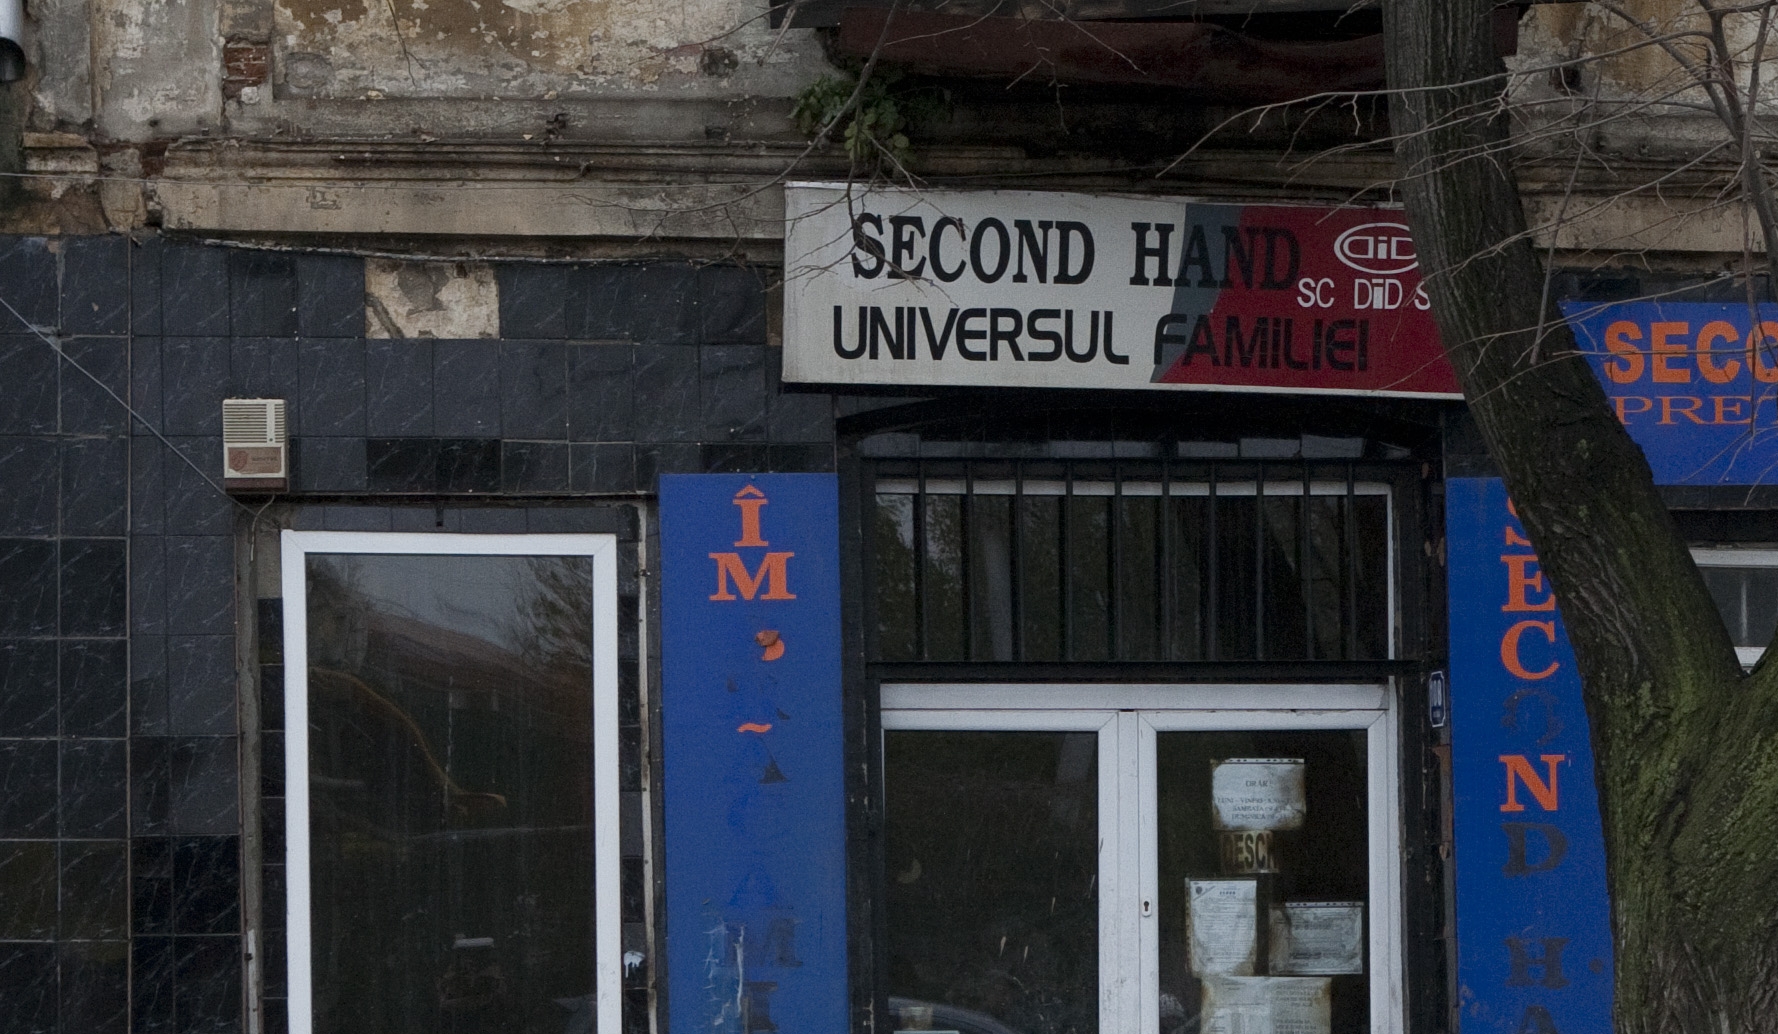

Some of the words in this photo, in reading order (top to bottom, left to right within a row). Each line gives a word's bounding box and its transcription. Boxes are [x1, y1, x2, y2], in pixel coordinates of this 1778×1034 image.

[851, 212, 1095, 286] SECOND
[1129, 223, 1300, 291] HAND
[1297, 277, 1335, 308] SC
[832, 305, 1130, 365] UNIVERSUL
[1152, 314, 1370, 372] FAMILIEI
